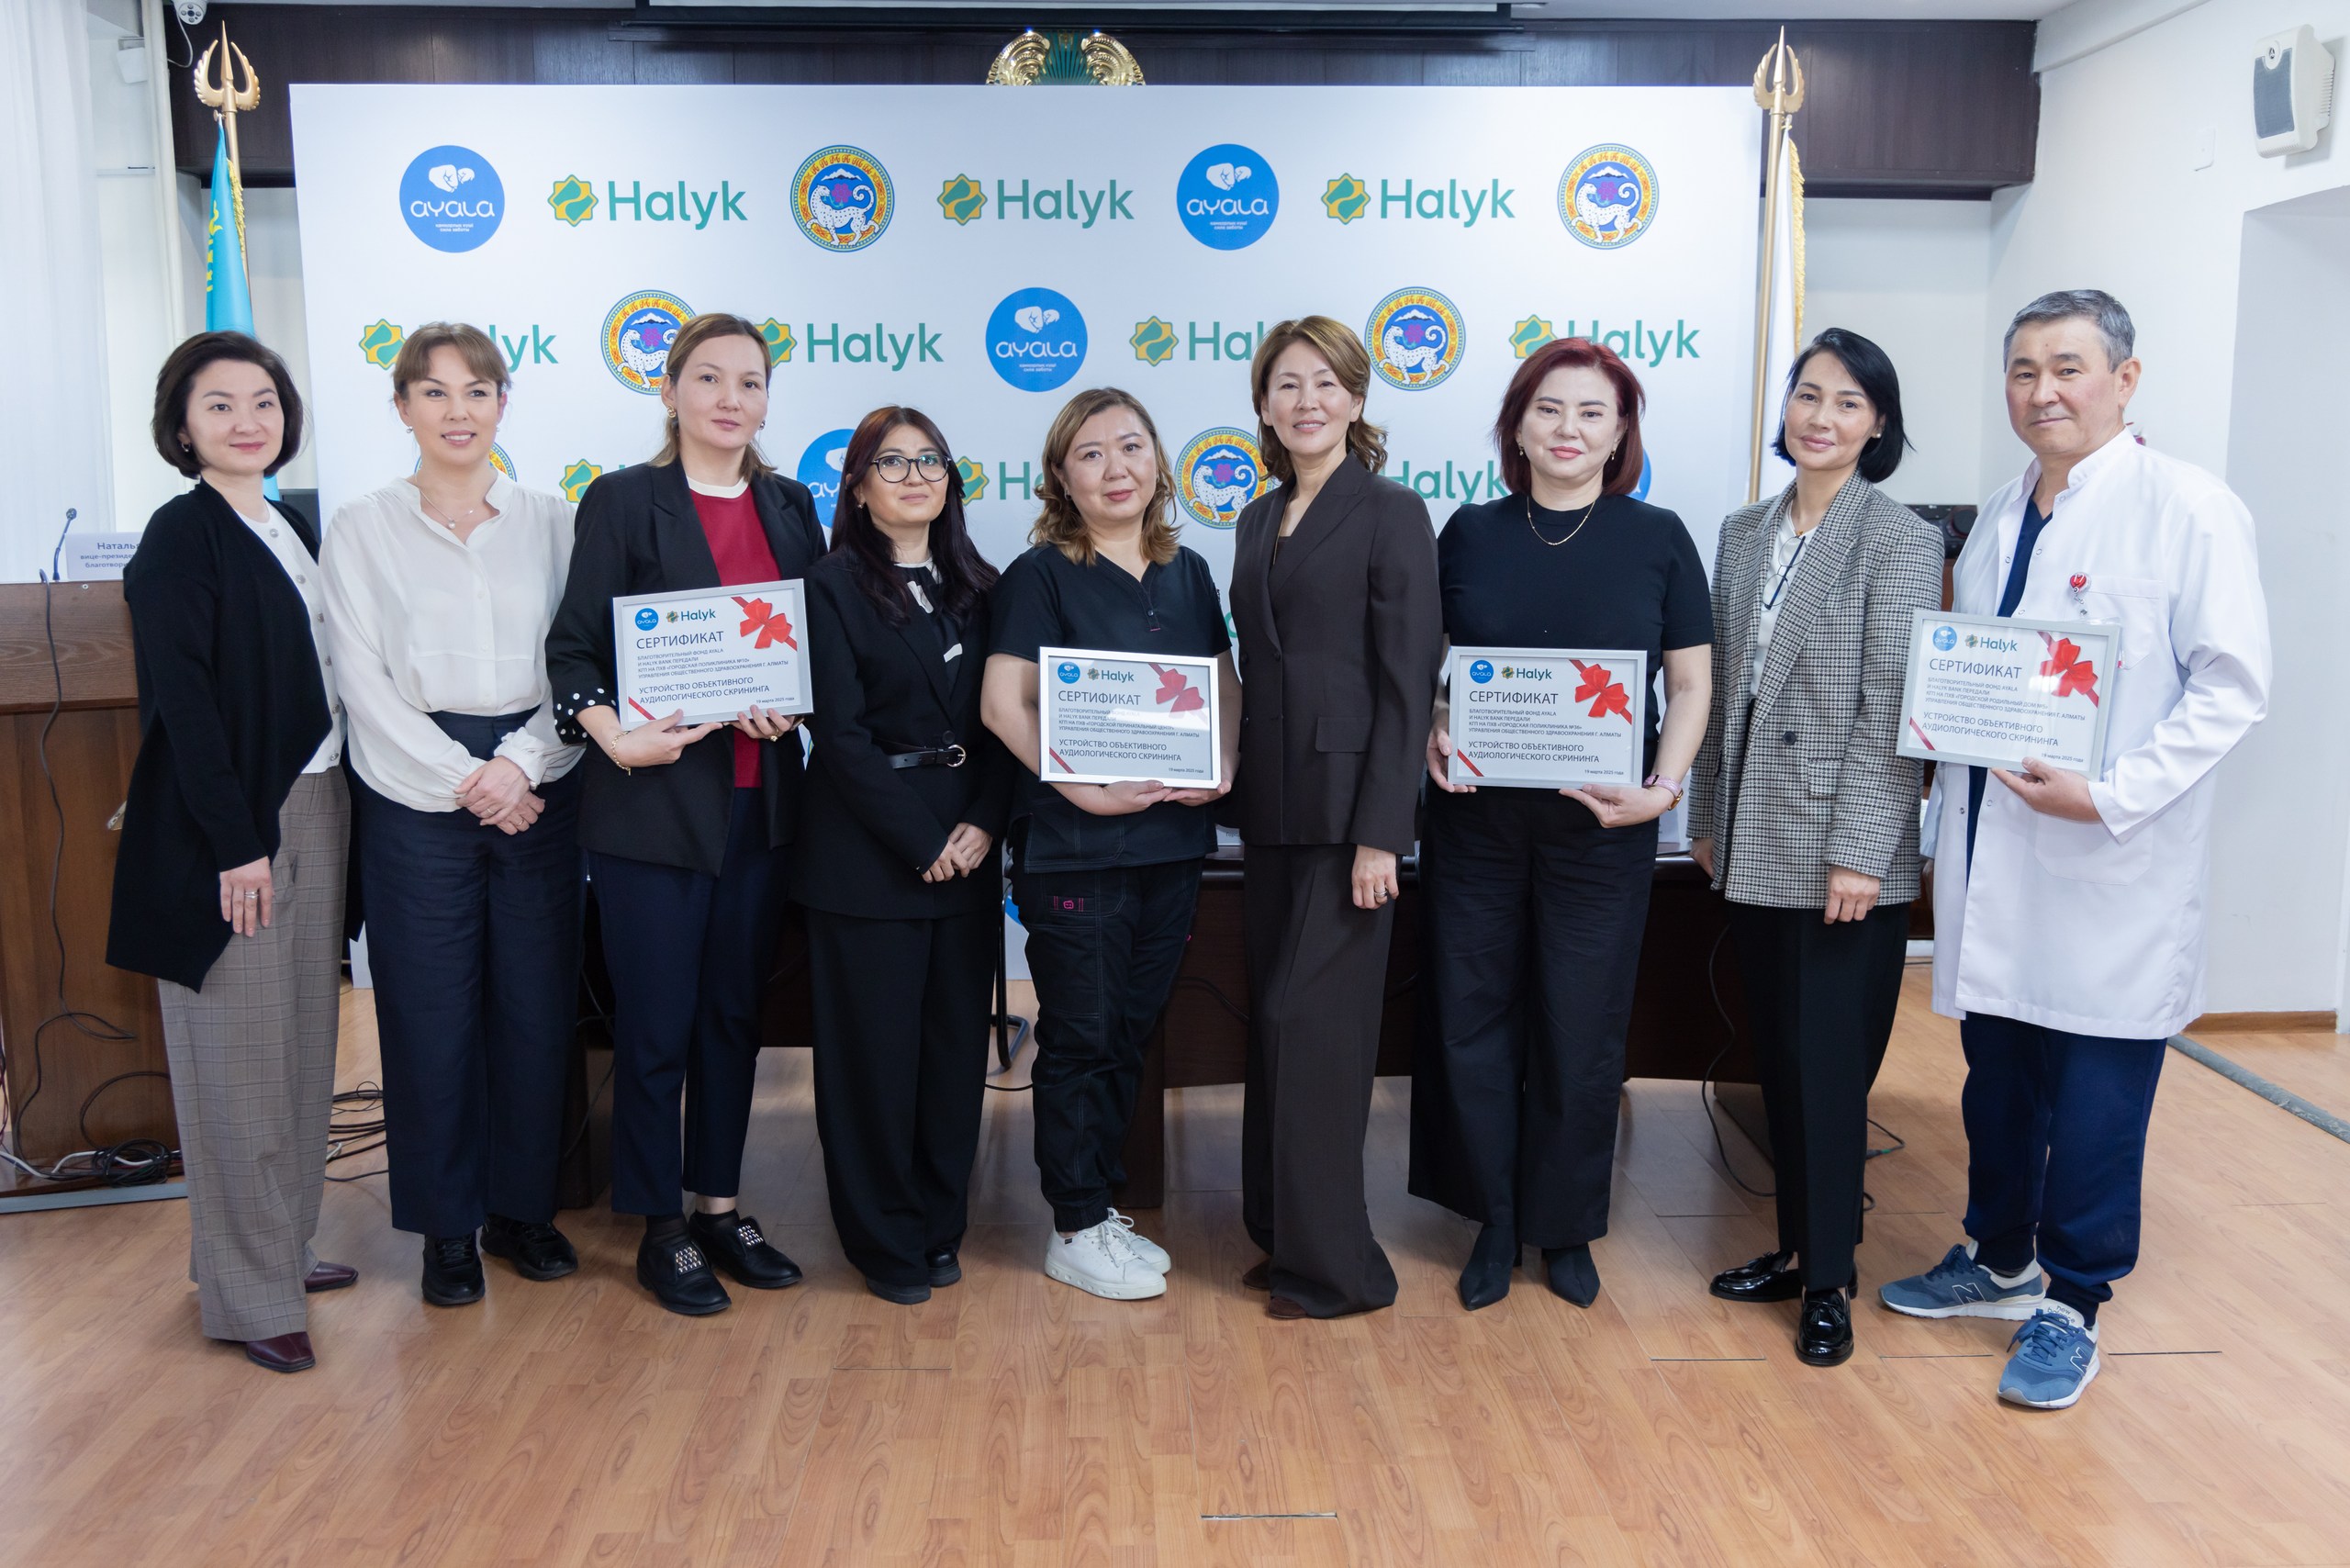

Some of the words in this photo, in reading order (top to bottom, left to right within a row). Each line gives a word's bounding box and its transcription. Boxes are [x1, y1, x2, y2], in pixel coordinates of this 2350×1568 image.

[608, 180, 747, 230] Halyk
[997, 178, 1133, 229] Halyk
[1381, 178, 1515, 228] Halyk
[806, 322, 943, 372] Halyk
[681, 609, 716, 622] Halyk
[636, 631, 723, 649] СЕРТИФИКАТ
[1980, 637, 2018, 652] Halyk
[637, 651, 692, 661] БЛАГОТВОРИТЕЛЬНЫЙ
[714, 663, 762, 672] ЗДРАВООХРАНЕНИЯ
[1516, 668, 1552, 681] Halyk
[1930, 658, 2022, 678] СЕРТИФИКАТ
[1102, 670, 1135, 683] Halyk
[639, 683, 690, 694] УСТРОЙСТВО
[692, 677, 754, 689] ОБЪЕКТИВНОГО
[640, 689, 722, 704] АУДИОЛОГИЧЕСКОГО
[723, 685, 769, 696] СКРИНИНГА
[1058, 690, 1141, 705] СЕРТИФИКАТ
[1469, 690, 1558, 704] СЕРТИФИКАТ
[1923, 711, 1975, 724] УСТРОЙСТВО
[1977, 718, 2042, 733] ОБЪЕКТИВНОГО
[1922, 722, 2007, 740] АУДИОЛОГИЧЕСКОГО
[2009, 734, 2058, 746] СКРИНИНГА
[1059, 739, 1108, 747] УСТРОЙСТВО
[1109, 742, 1167, 751] ОБЪЕКТИВНОГО
[1521, 744, 1583, 752] ОБЪЕКТИВНОГО
[1059, 749, 1137, 759] АУДИОЛОГИЧЕСКОГО
[1138, 753, 1181, 761] СКРИНИНГА
[1469, 751, 1550, 761] АУДИОЛОГИЧЕСКОГО
